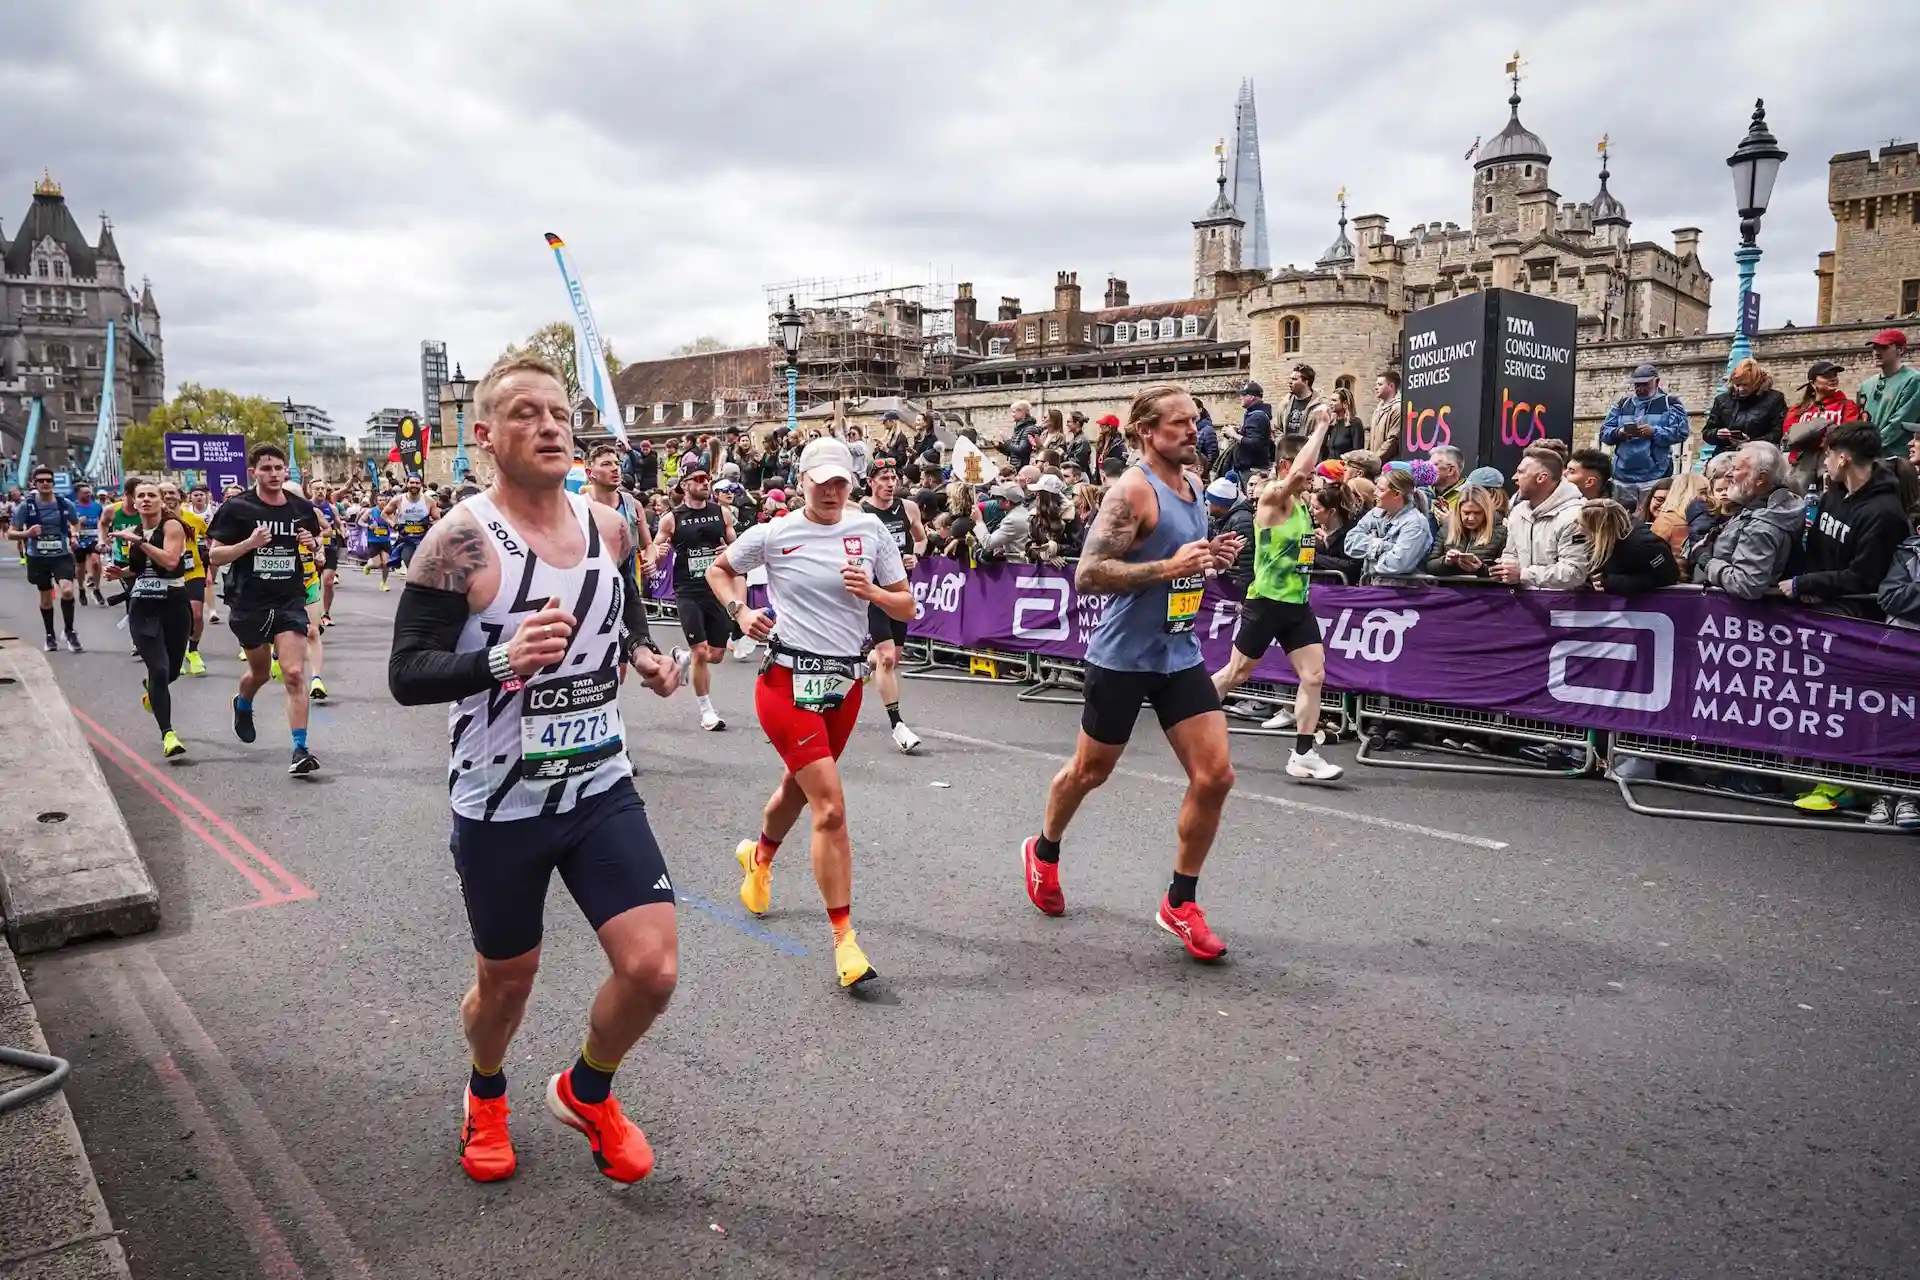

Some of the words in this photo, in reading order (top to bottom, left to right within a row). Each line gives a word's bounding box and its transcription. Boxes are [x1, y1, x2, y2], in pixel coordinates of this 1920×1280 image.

[1507, 316, 1535, 337] TATA
[1409, 331, 1437, 351] TATA
[1505, 338, 1570, 364] CONSULTANCY
[1408, 340, 1477, 370] CONSULTANCY
[1408, 367, 1451, 390] SERVICES
[1504, 358, 1547, 381] SERVICES
[1406, 400, 1452, 453] tcs
[1501, 387, 1547, 447] tcs
[256, 520, 298, 536] WILL
[681, 515, 720, 526] STRONG
[261, 559, 290, 569] 39509
[1697, 613, 1839, 654] ABBOTT
[797, 655, 821, 671] tcs
[1697, 640, 1826, 677] WORLD
[572, 678, 593, 688] TATA
[572, 680, 615, 697] CONSULTANCY
[1694, 668, 1916, 720] MARATHON
[530, 688, 568, 709] tcs
[572, 692, 604, 705] SERVICES
[1692, 696, 1846, 739] MAJORS
[541, 712, 608, 748] 47273
[568, 764, 586, 774] new
